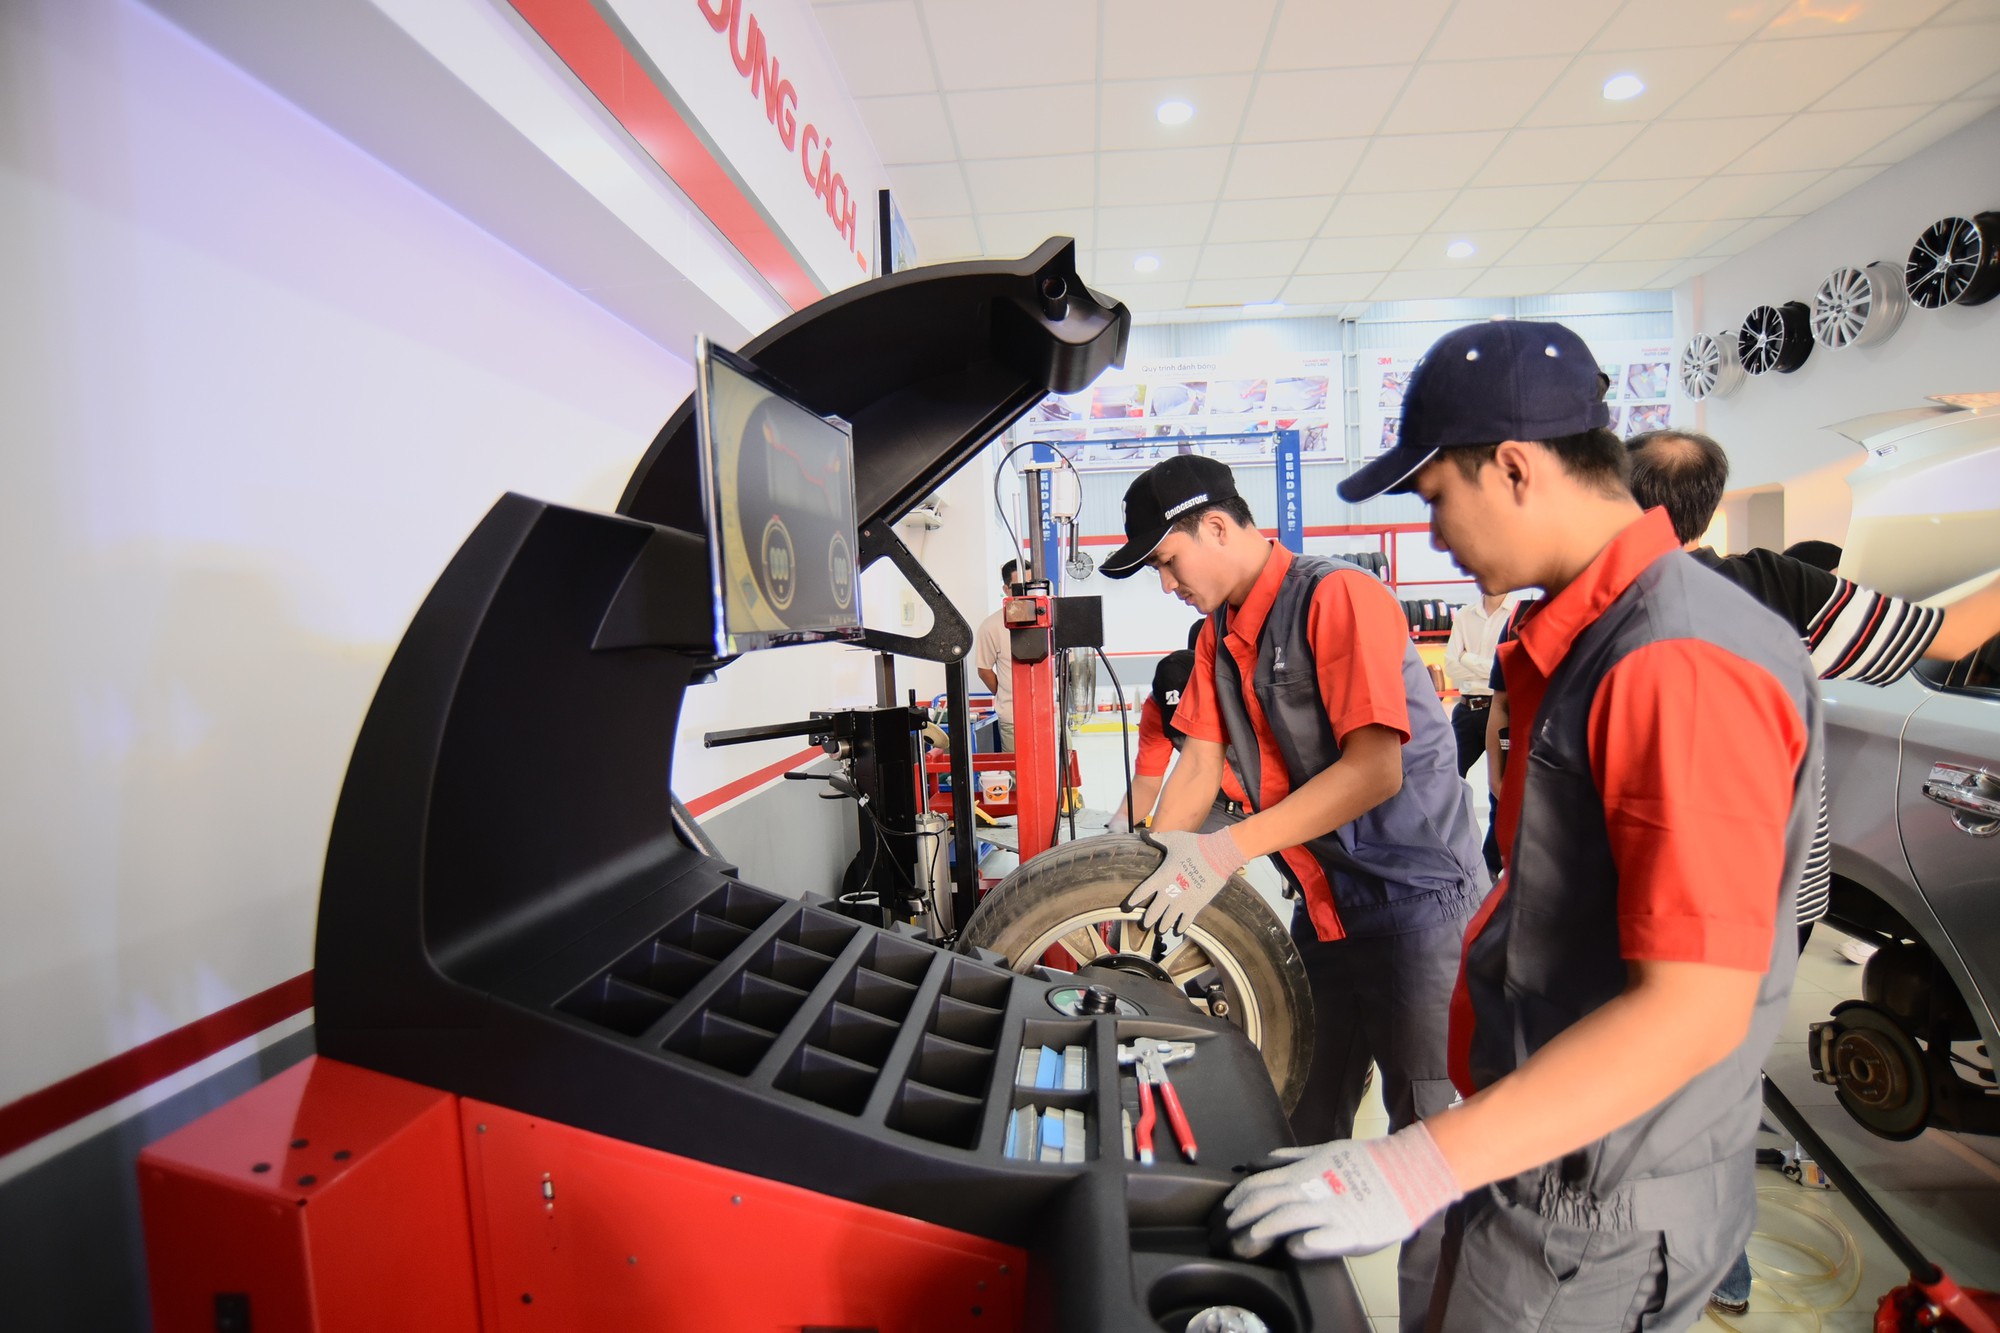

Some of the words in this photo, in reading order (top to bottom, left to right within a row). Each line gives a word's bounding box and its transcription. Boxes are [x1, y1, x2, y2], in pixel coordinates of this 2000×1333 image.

[801, 123, 857, 253] CÁCH
[1377, 357, 1392, 365] 3M
[1040, 470, 1051, 530] ENDPAK
[1164, 493, 1209, 520] BRIDGESTONE
[1176, 872, 1190, 890] 3M
[1323, 1168, 1346, 1195] 3M
